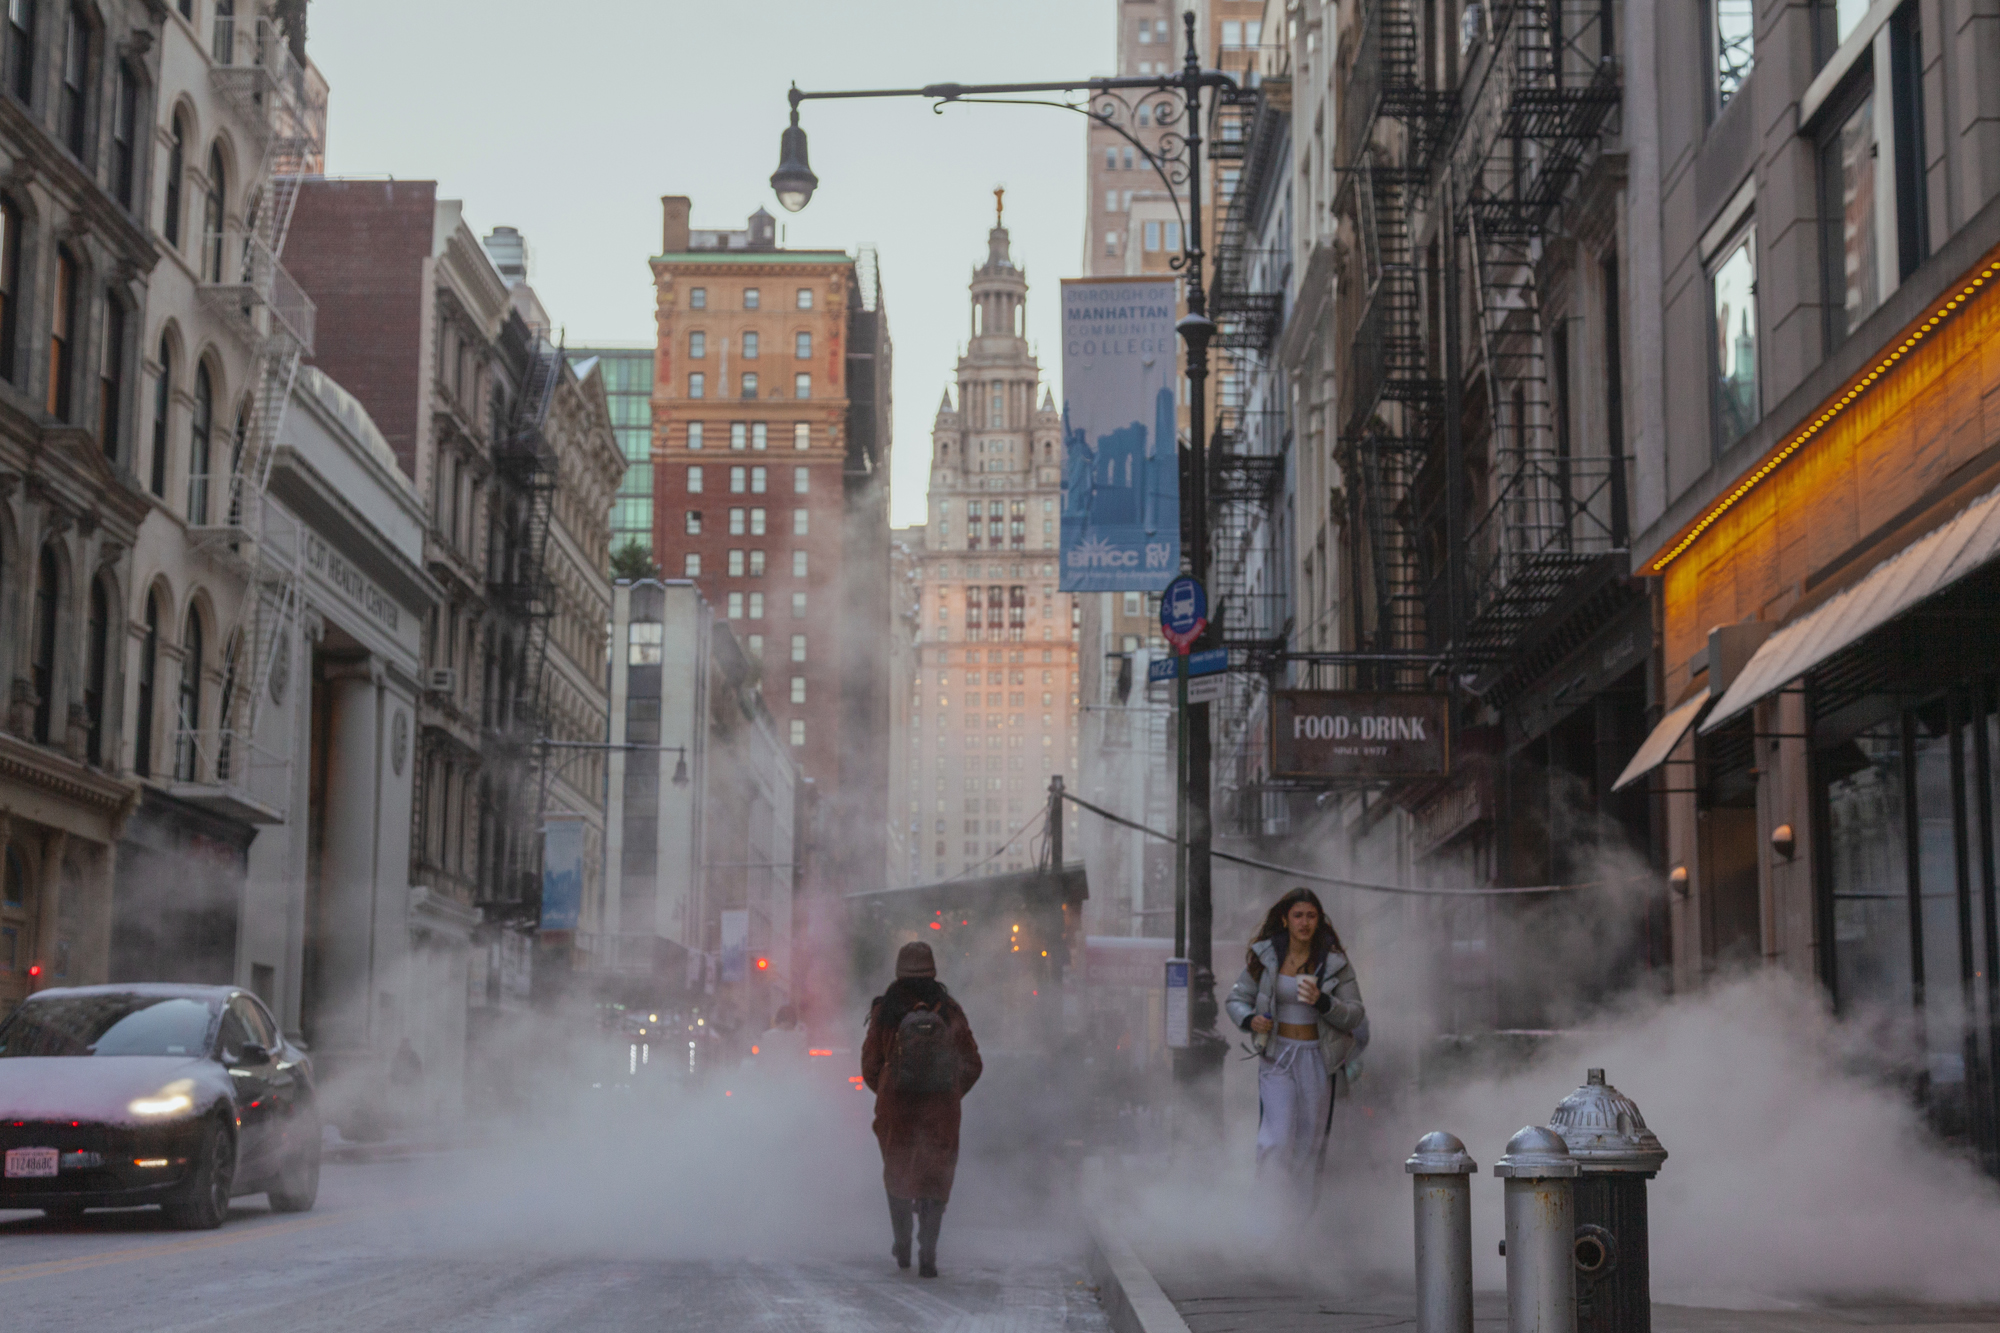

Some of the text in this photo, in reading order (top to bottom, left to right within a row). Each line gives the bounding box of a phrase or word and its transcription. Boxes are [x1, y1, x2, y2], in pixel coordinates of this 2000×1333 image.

[1067, 287, 1167, 303] BOROUGH OF
[1067, 305, 1169, 320] MANHATTAN
[1067, 322, 1168, 337] COMMUNITY
[1068, 338, 1168, 357] COLLEGE
[1150, 659, 1174, 678] M22
[1293, 715, 1350, 739] FOOD
[1361, 715, 1426, 741] DRINK
